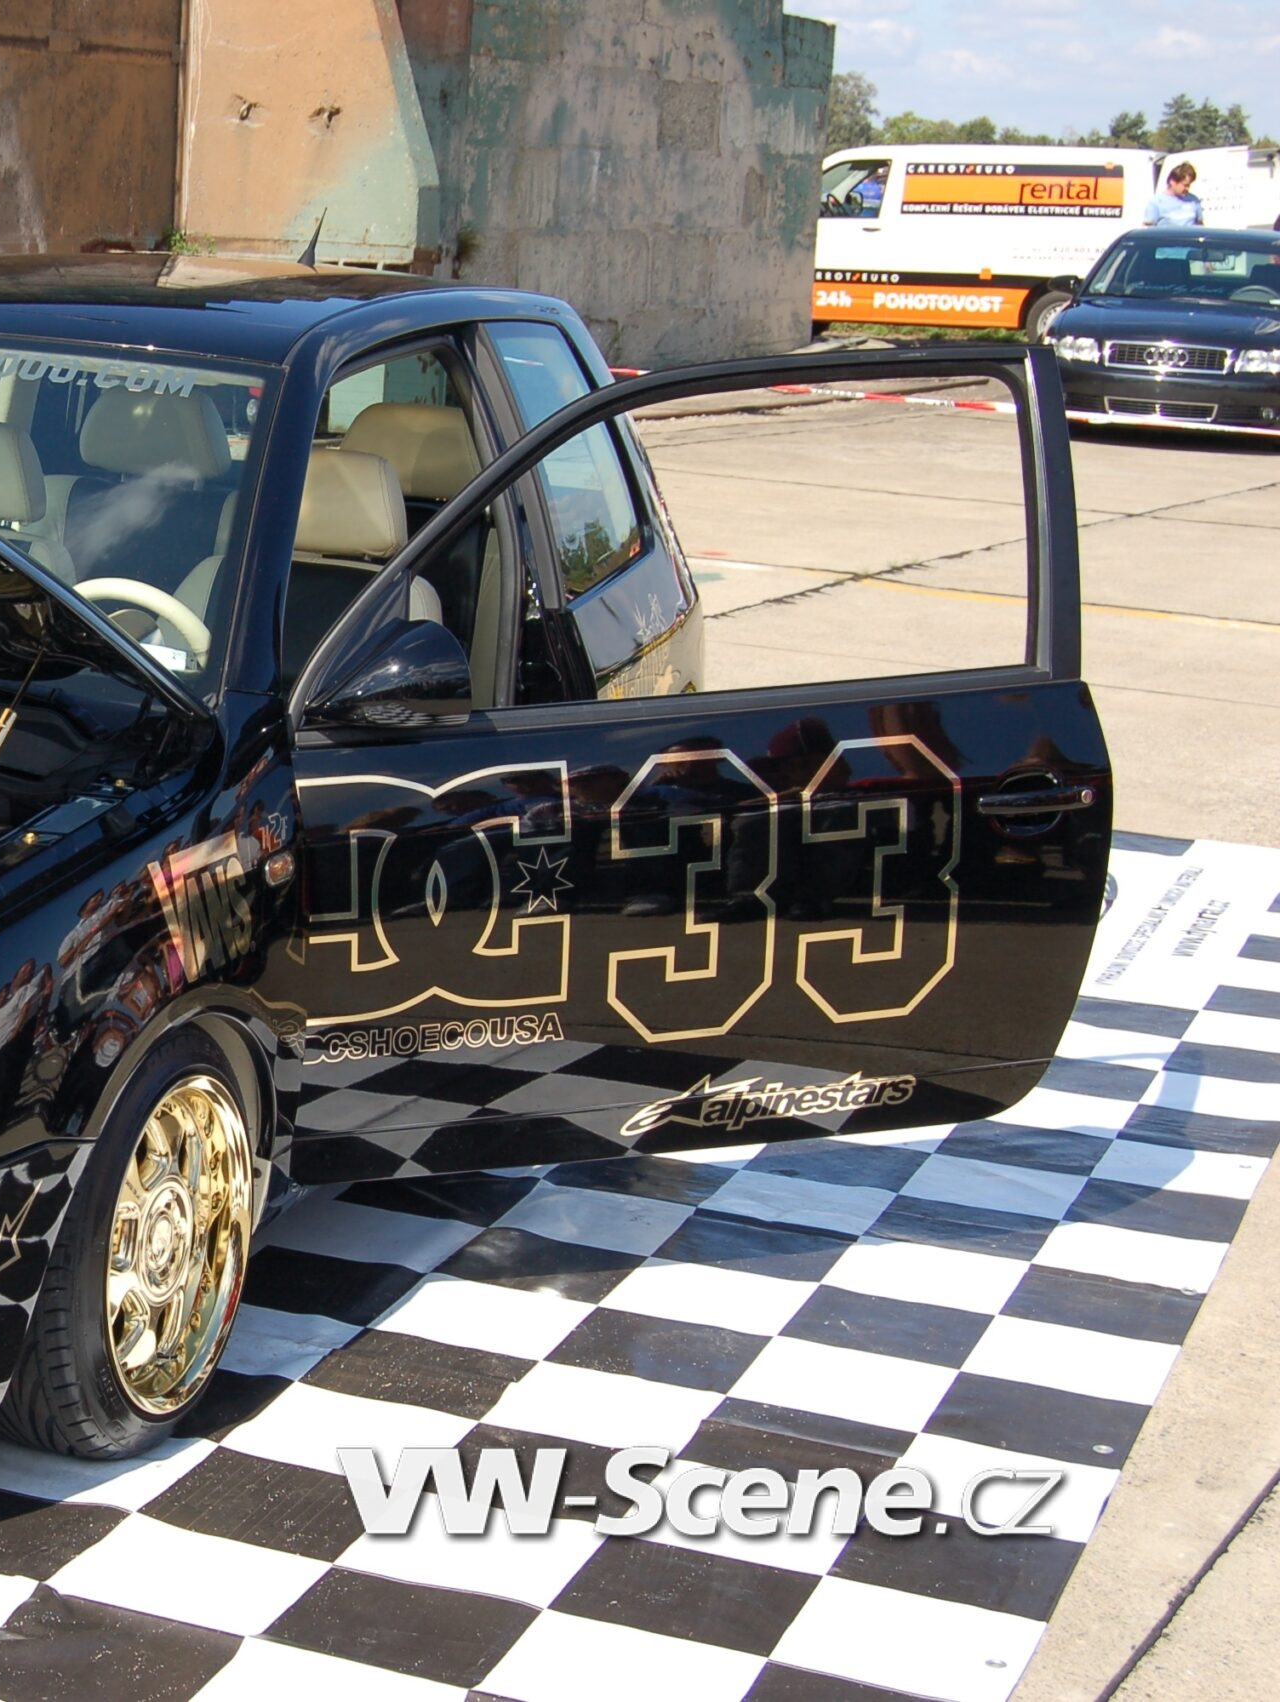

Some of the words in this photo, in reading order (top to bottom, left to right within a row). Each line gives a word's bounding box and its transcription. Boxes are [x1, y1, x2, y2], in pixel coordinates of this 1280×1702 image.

[975, 165, 1016, 175] EURO
[1019, 177, 1099, 204] rental
[861, 272, 900, 284] EURO
[816, 290, 852, 307] 24h
[873, 291, 1004, 313] POHOTOVOST
[607, 733, 962, 1044] 33
[147, 830, 252, 983] VANS
[700, 1071, 917, 1131] alpinestars
